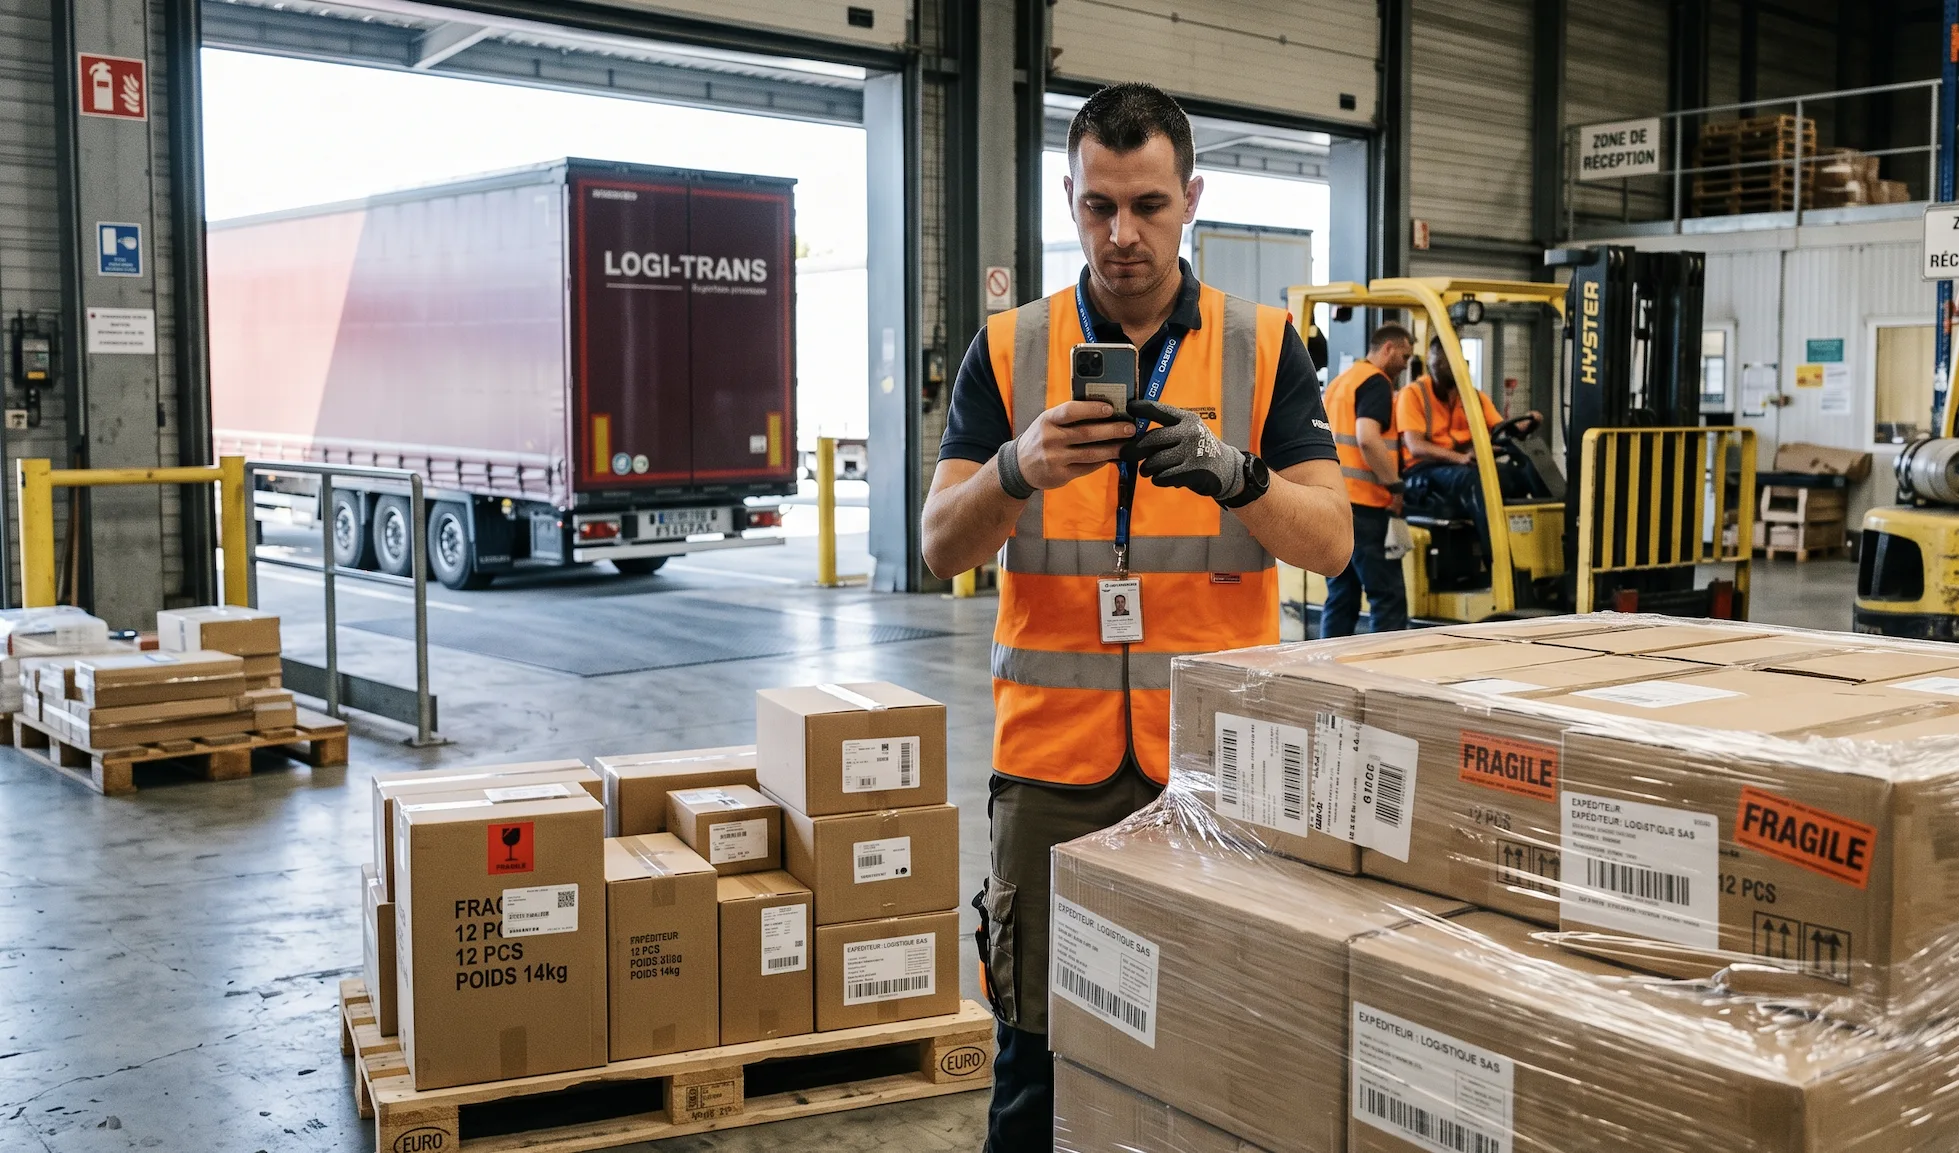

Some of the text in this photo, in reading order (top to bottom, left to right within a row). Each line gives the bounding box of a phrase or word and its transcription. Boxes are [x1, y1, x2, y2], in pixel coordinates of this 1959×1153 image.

[1593, 128, 1647, 149] ZONE DE
[604, 250, 768, 283] LOGI-TRANS
[1581, 281, 1600, 385] HYSTER
[1464, 743, 1553, 789] FRAGILE
[1677, 828, 1695, 840] SAS
[1742, 802, 1868, 873] FRAGILE
[1718, 873, 1777, 904] 12 PCS
[455, 923, 477, 943] 12
[456, 942, 524, 967] 12 PCS
[631, 944, 660, 956] 12 PCS
[1136, 943, 1151, 957] SAS
[630, 956, 658, 968] POIDS
[456, 962, 567, 990] POIDS 14kg
[630, 966, 680, 980] POIDS 14kg
[945, 1050, 981, 1071] EURO
[1480, 1057, 1500, 1073] SAS
[403, 1133, 442, 1153] EURO
